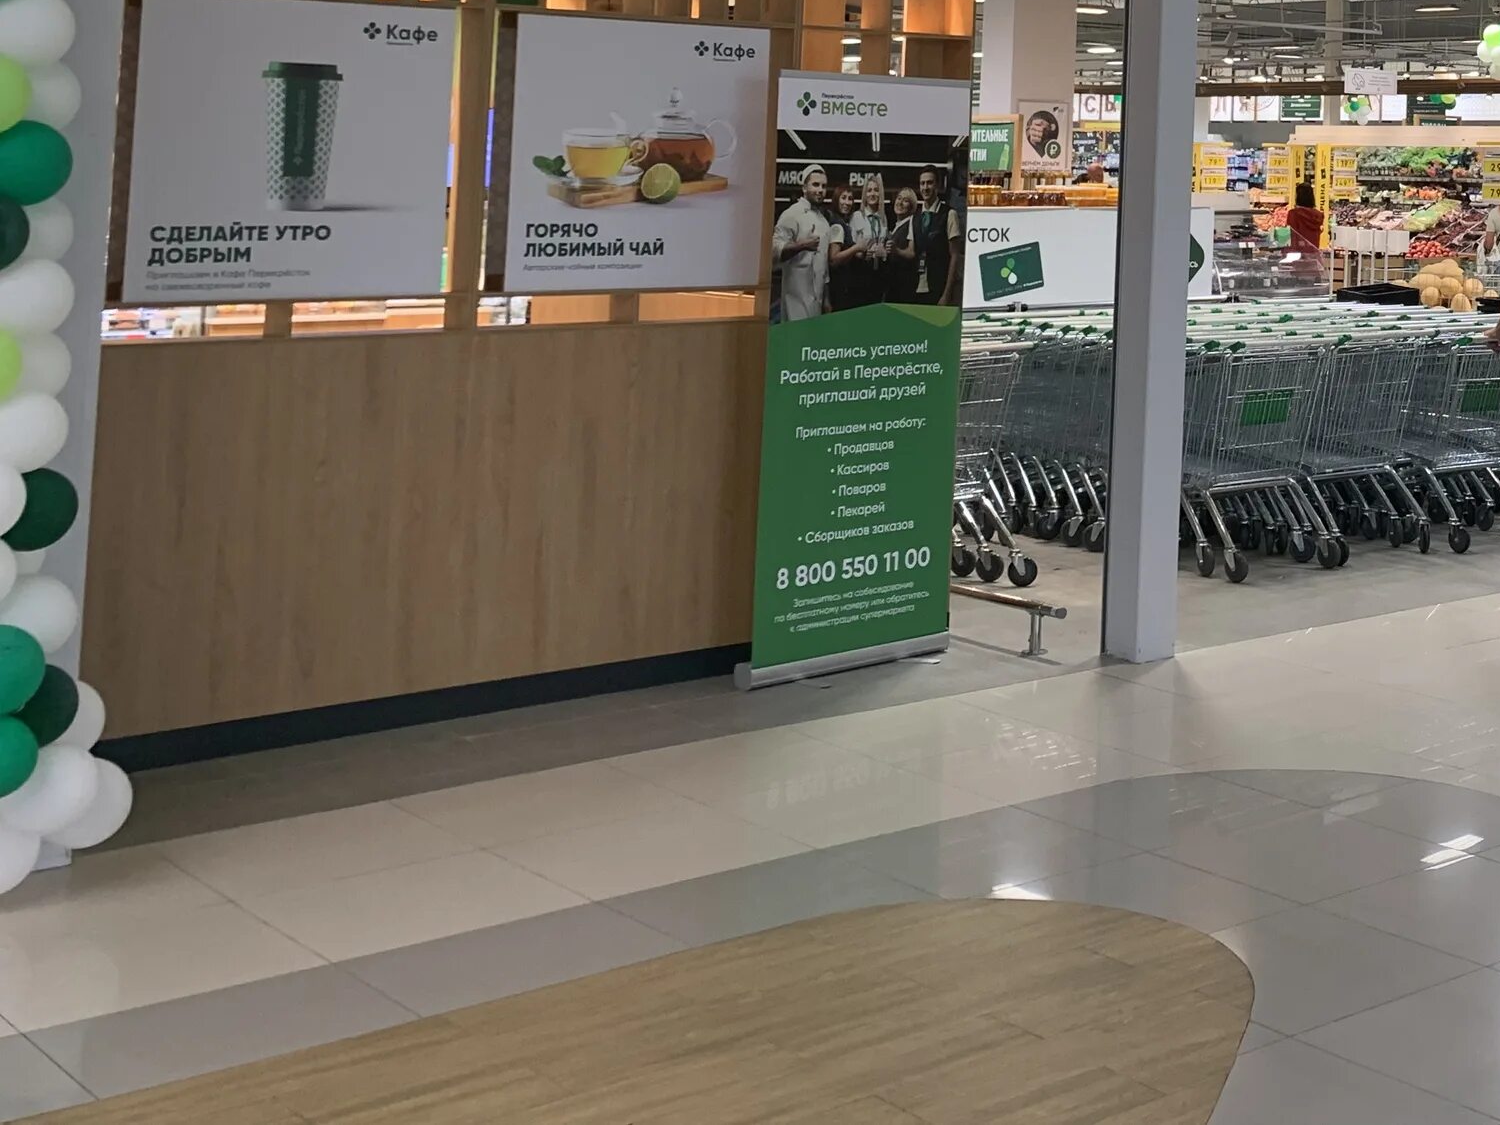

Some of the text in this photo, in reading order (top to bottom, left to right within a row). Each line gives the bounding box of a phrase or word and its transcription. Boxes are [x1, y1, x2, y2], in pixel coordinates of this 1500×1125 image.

[386, 23, 438, 45] Кафе
[713, 42, 756, 61] Кафе
[149, 221, 331, 245] СДЕЛАЙТЕ УТРО
[525, 223, 599, 238] ГОРЯЧО
[966, 227, 1010, 244] СТОК
[147, 247, 252, 267] ДОБРЫМ
[523, 237, 665, 258] ЛЮБИМЫЙ ЧАЙ
[801, 339, 928, 362] Поделись успехом!
[780, 361, 944, 385] Работай в Перекрёстке,
[799, 381, 927, 408] приглашай друзей
[795, 416, 926, 441] Приглашаем на работу:
[833, 439, 895, 457] Продавцов
[837, 460, 890, 476] Кассиров
[838, 482, 887, 497] Поваров
[837, 501, 886, 518] Пекарей
[804, 519, 915, 544] Сборщиков заказов
[776, 546, 931, 590] 8 800 550 11 00
